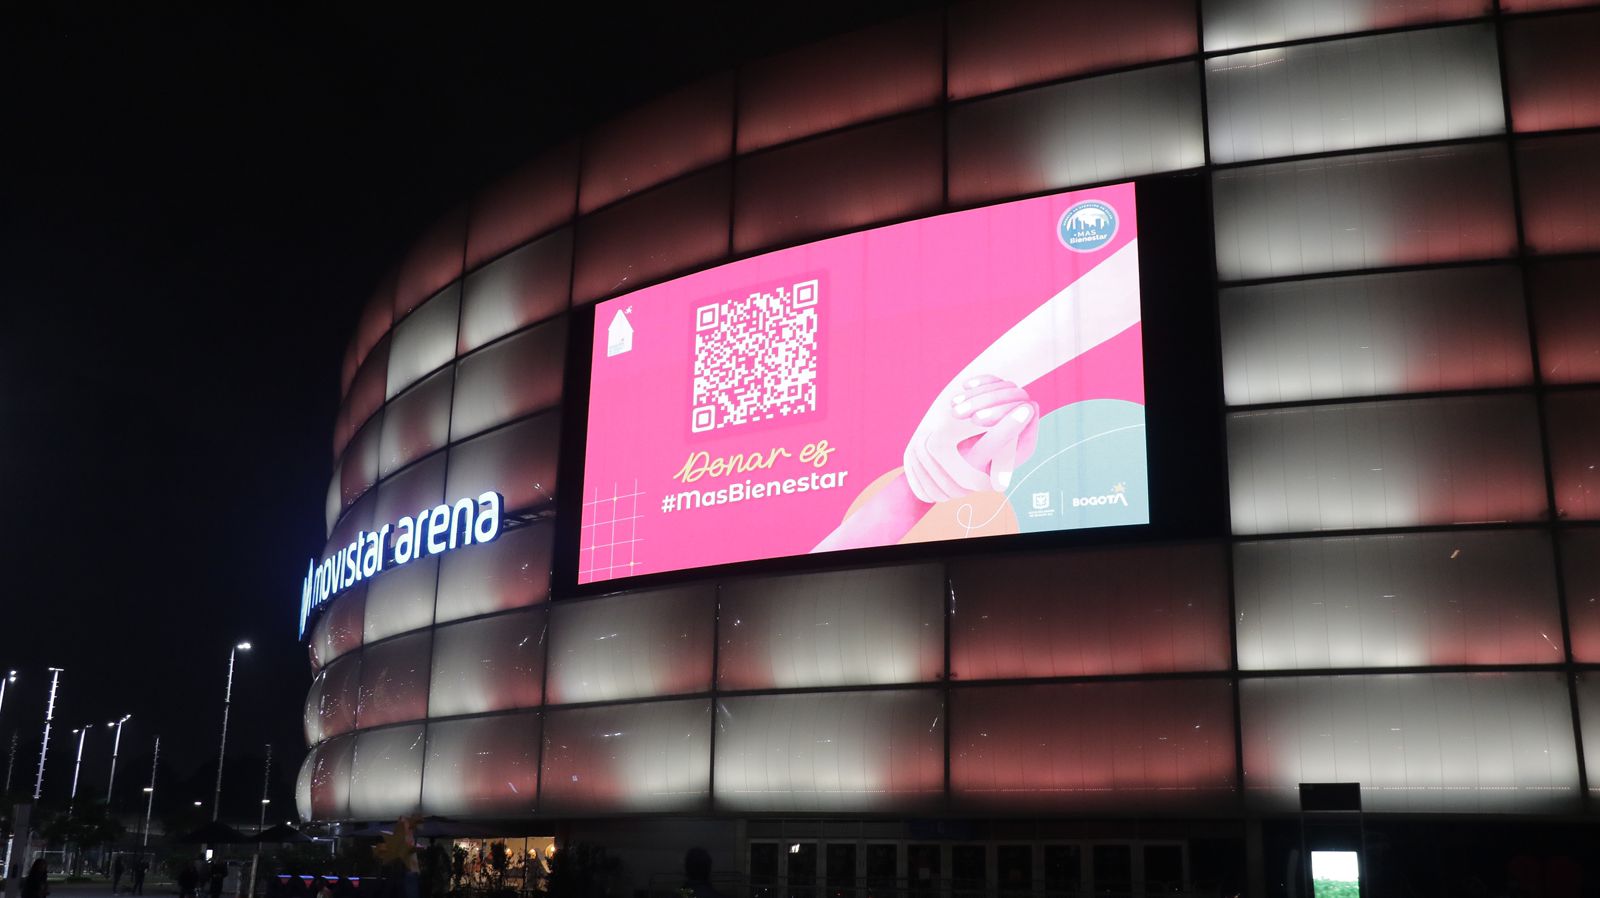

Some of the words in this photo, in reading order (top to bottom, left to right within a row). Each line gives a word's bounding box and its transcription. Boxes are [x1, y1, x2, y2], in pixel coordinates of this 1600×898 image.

[1070, 233, 1108, 244] Bienestar
[673, 446, 792, 483] Donar
[799, 439, 836, 468] es
[661, 470, 849, 513] #MasBienestar
[312, 523, 390, 609] movistar
[394, 490, 502, 565] arena
